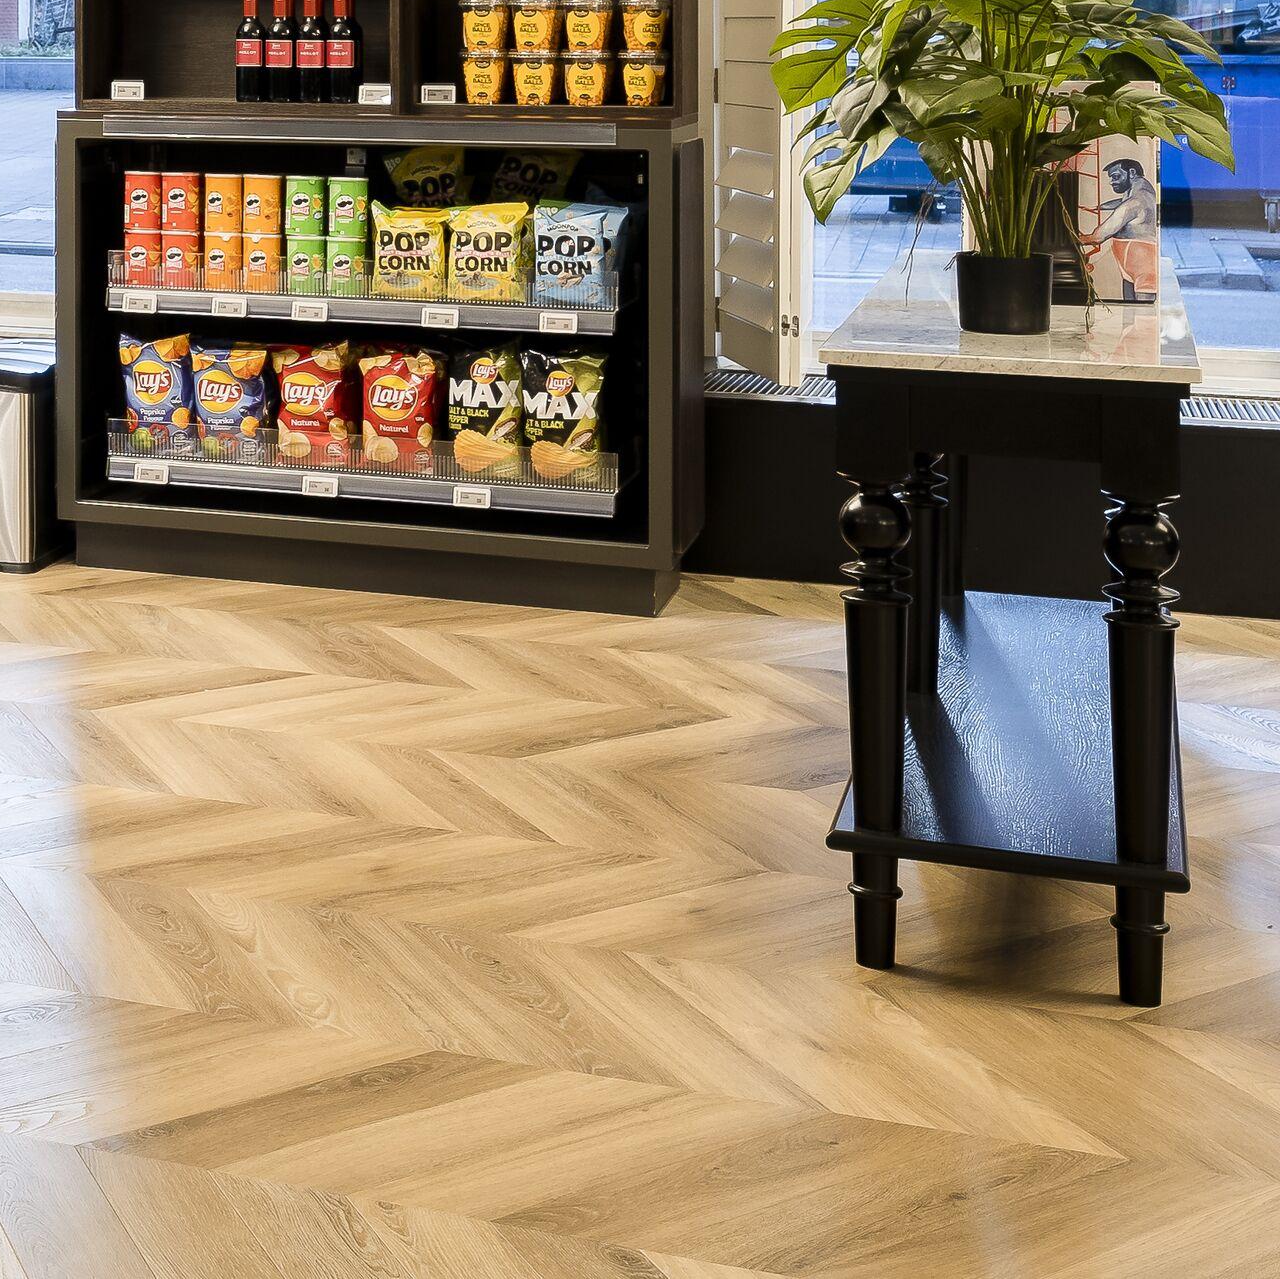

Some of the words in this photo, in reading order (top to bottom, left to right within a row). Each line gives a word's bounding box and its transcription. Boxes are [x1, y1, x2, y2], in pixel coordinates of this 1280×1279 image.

[380, 230, 430, 252] POP
[456, 232, 512, 252] POP
[538, 235, 595, 257] POP
[378, 256, 430, 271] CORN
[455, 257, 508, 272] CORN
[538, 260, 592, 276] CORN
[472, 364, 496, 378] Lay's
[136, 372, 170, 394] Lay's
[200, 380, 240, 402] Lay's
[548, 377, 572, 391] Lay's
[284, 382, 325, 406] Lay's
[372, 385, 415, 410] Lay's
[449, 378, 521, 408] MAX
[467, 408, 489, 418] BLACK
[522, 390, 600, 420] MAX
[208, 418, 234, 426] Paprika
[380, 424, 409, 433] Naturel
[541, 419, 564, 429] BLACK
